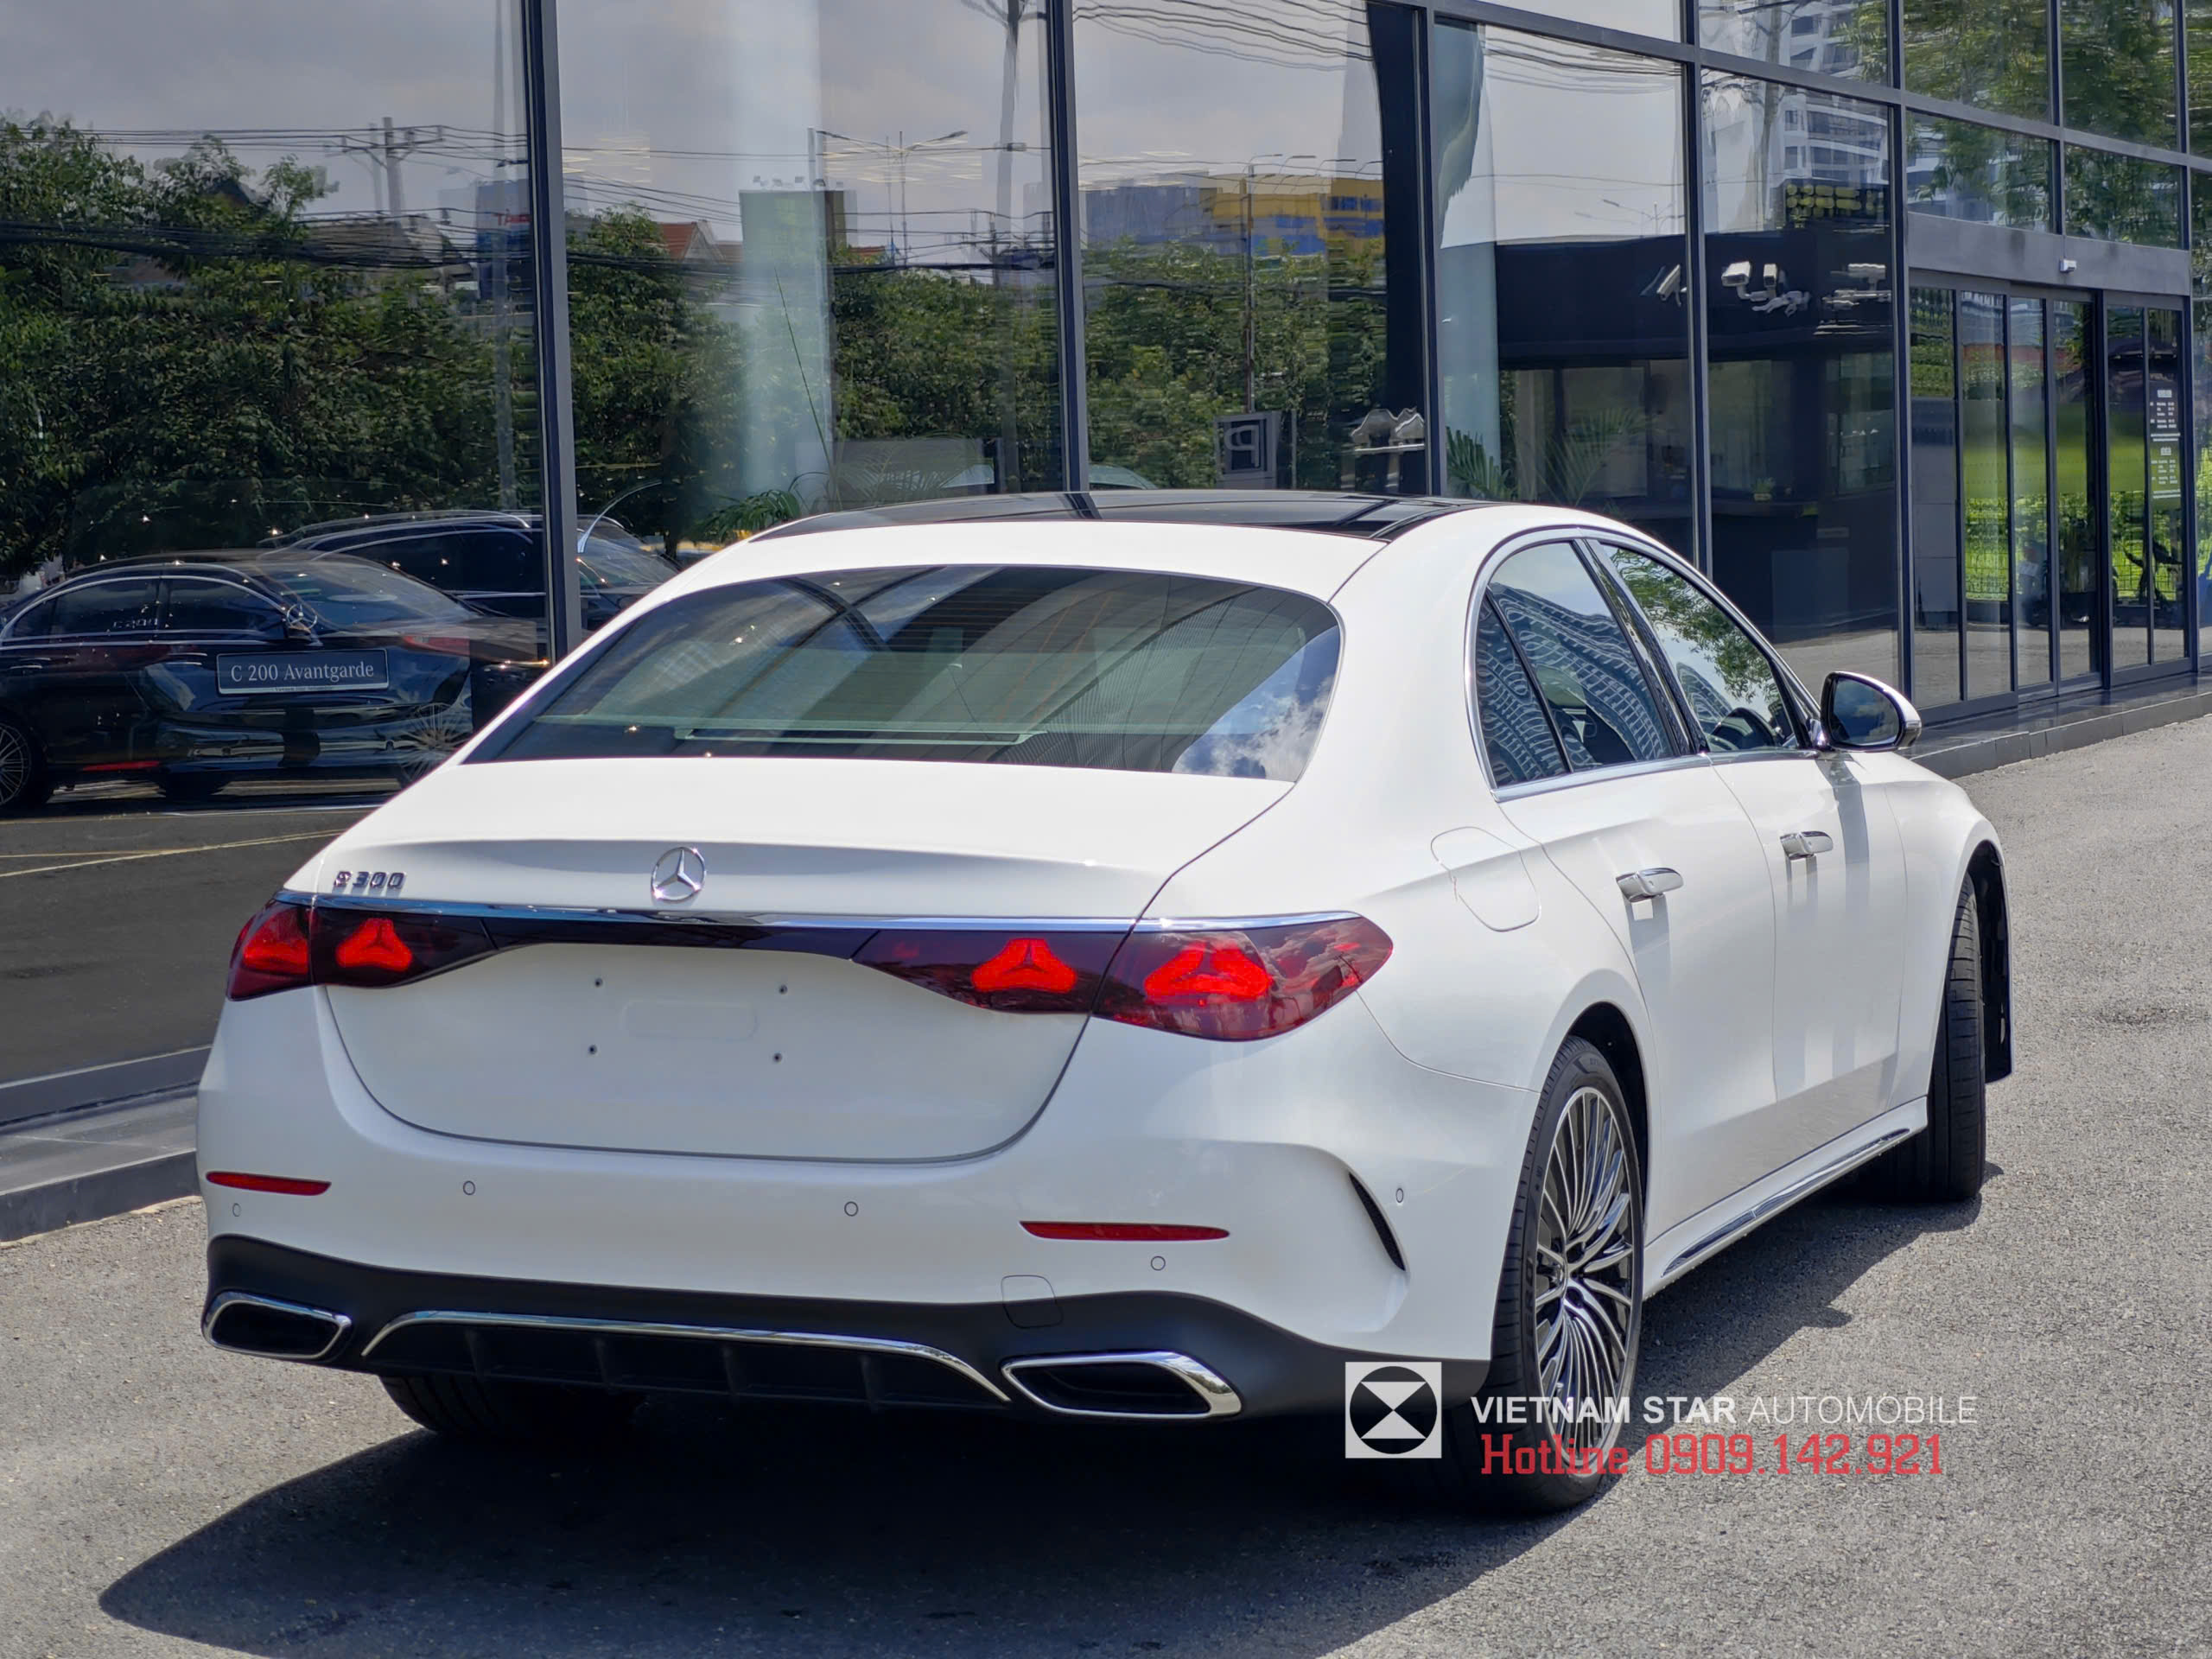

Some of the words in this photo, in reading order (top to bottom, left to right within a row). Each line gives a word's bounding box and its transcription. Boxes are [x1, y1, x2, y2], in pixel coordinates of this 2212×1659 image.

[231, 664, 243, 682] C
[248, 664, 278, 681] 200
[283, 660, 374, 683] Avantgarde
